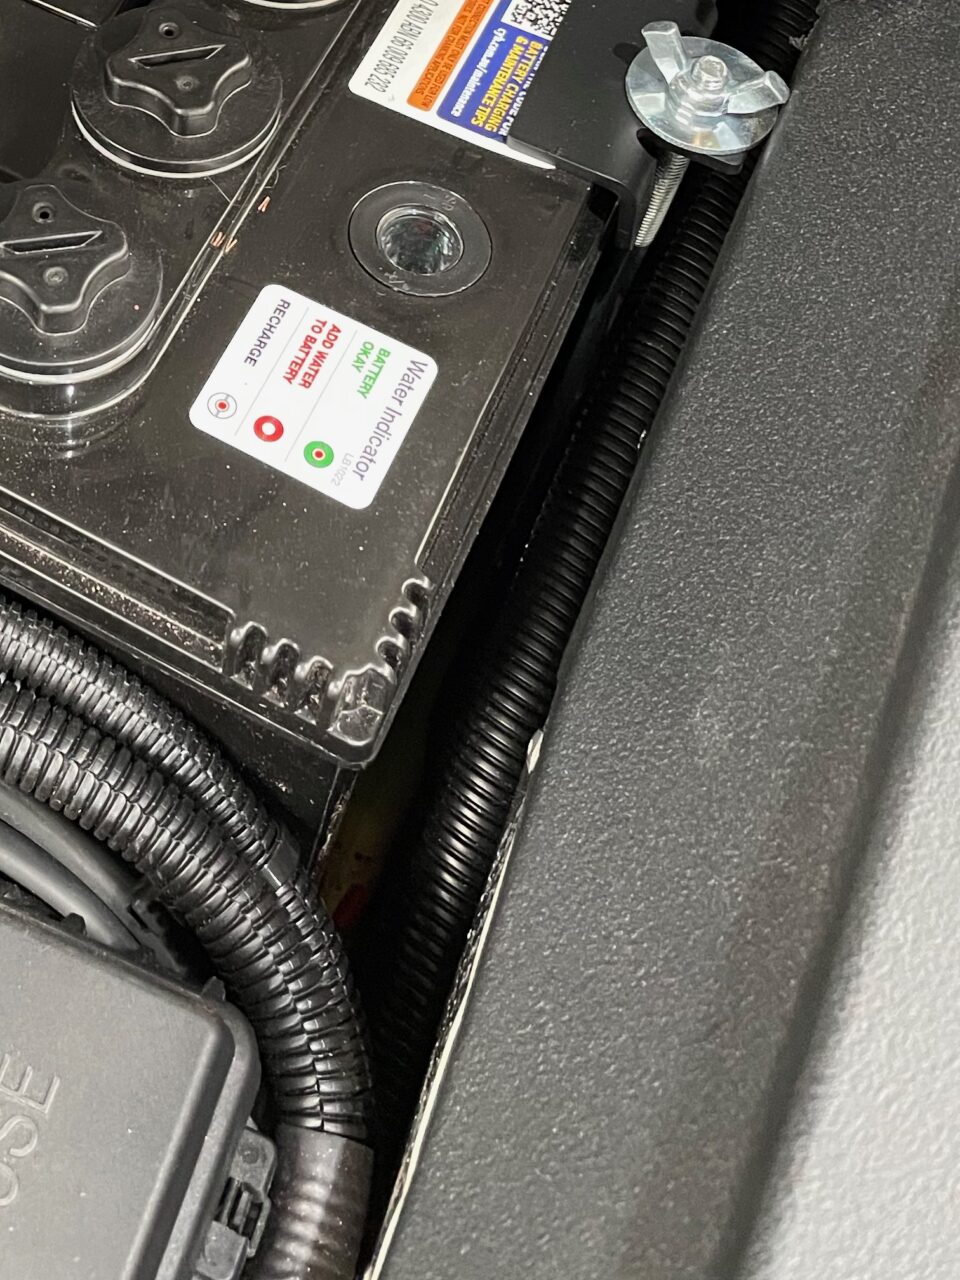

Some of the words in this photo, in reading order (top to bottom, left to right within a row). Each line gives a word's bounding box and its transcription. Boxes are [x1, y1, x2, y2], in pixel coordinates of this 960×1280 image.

[395, 18, 425, 41] ABN
[405, 1, 435, 25] 4300
[380, 44, 409, 65] 009
[389, 34, 415, 50] 66
[372, 58, 401, 79] 685
[480, 42, 525, 108] MAINTENANCE
[510, 39, 544, 85] BATTERY
[362, 72, 392, 94] 232
[469, 103, 491, 128] TIPS
[483, 81, 520, 134] CHARGING
[242, 298, 291, 367] RECHARGE
[309, 316, 327, 335] TO
[320, 323, 343, 350] ADD
[280, 333, 317, 384] BATTERY
[297, 348, 328, 389] WATER
[348, 339, 376, 373] OKAY
[354, 346, 391, 399] BATTERY
[388, 356, 429, 409] Water
[348, 405, 403, 483] Indicator
